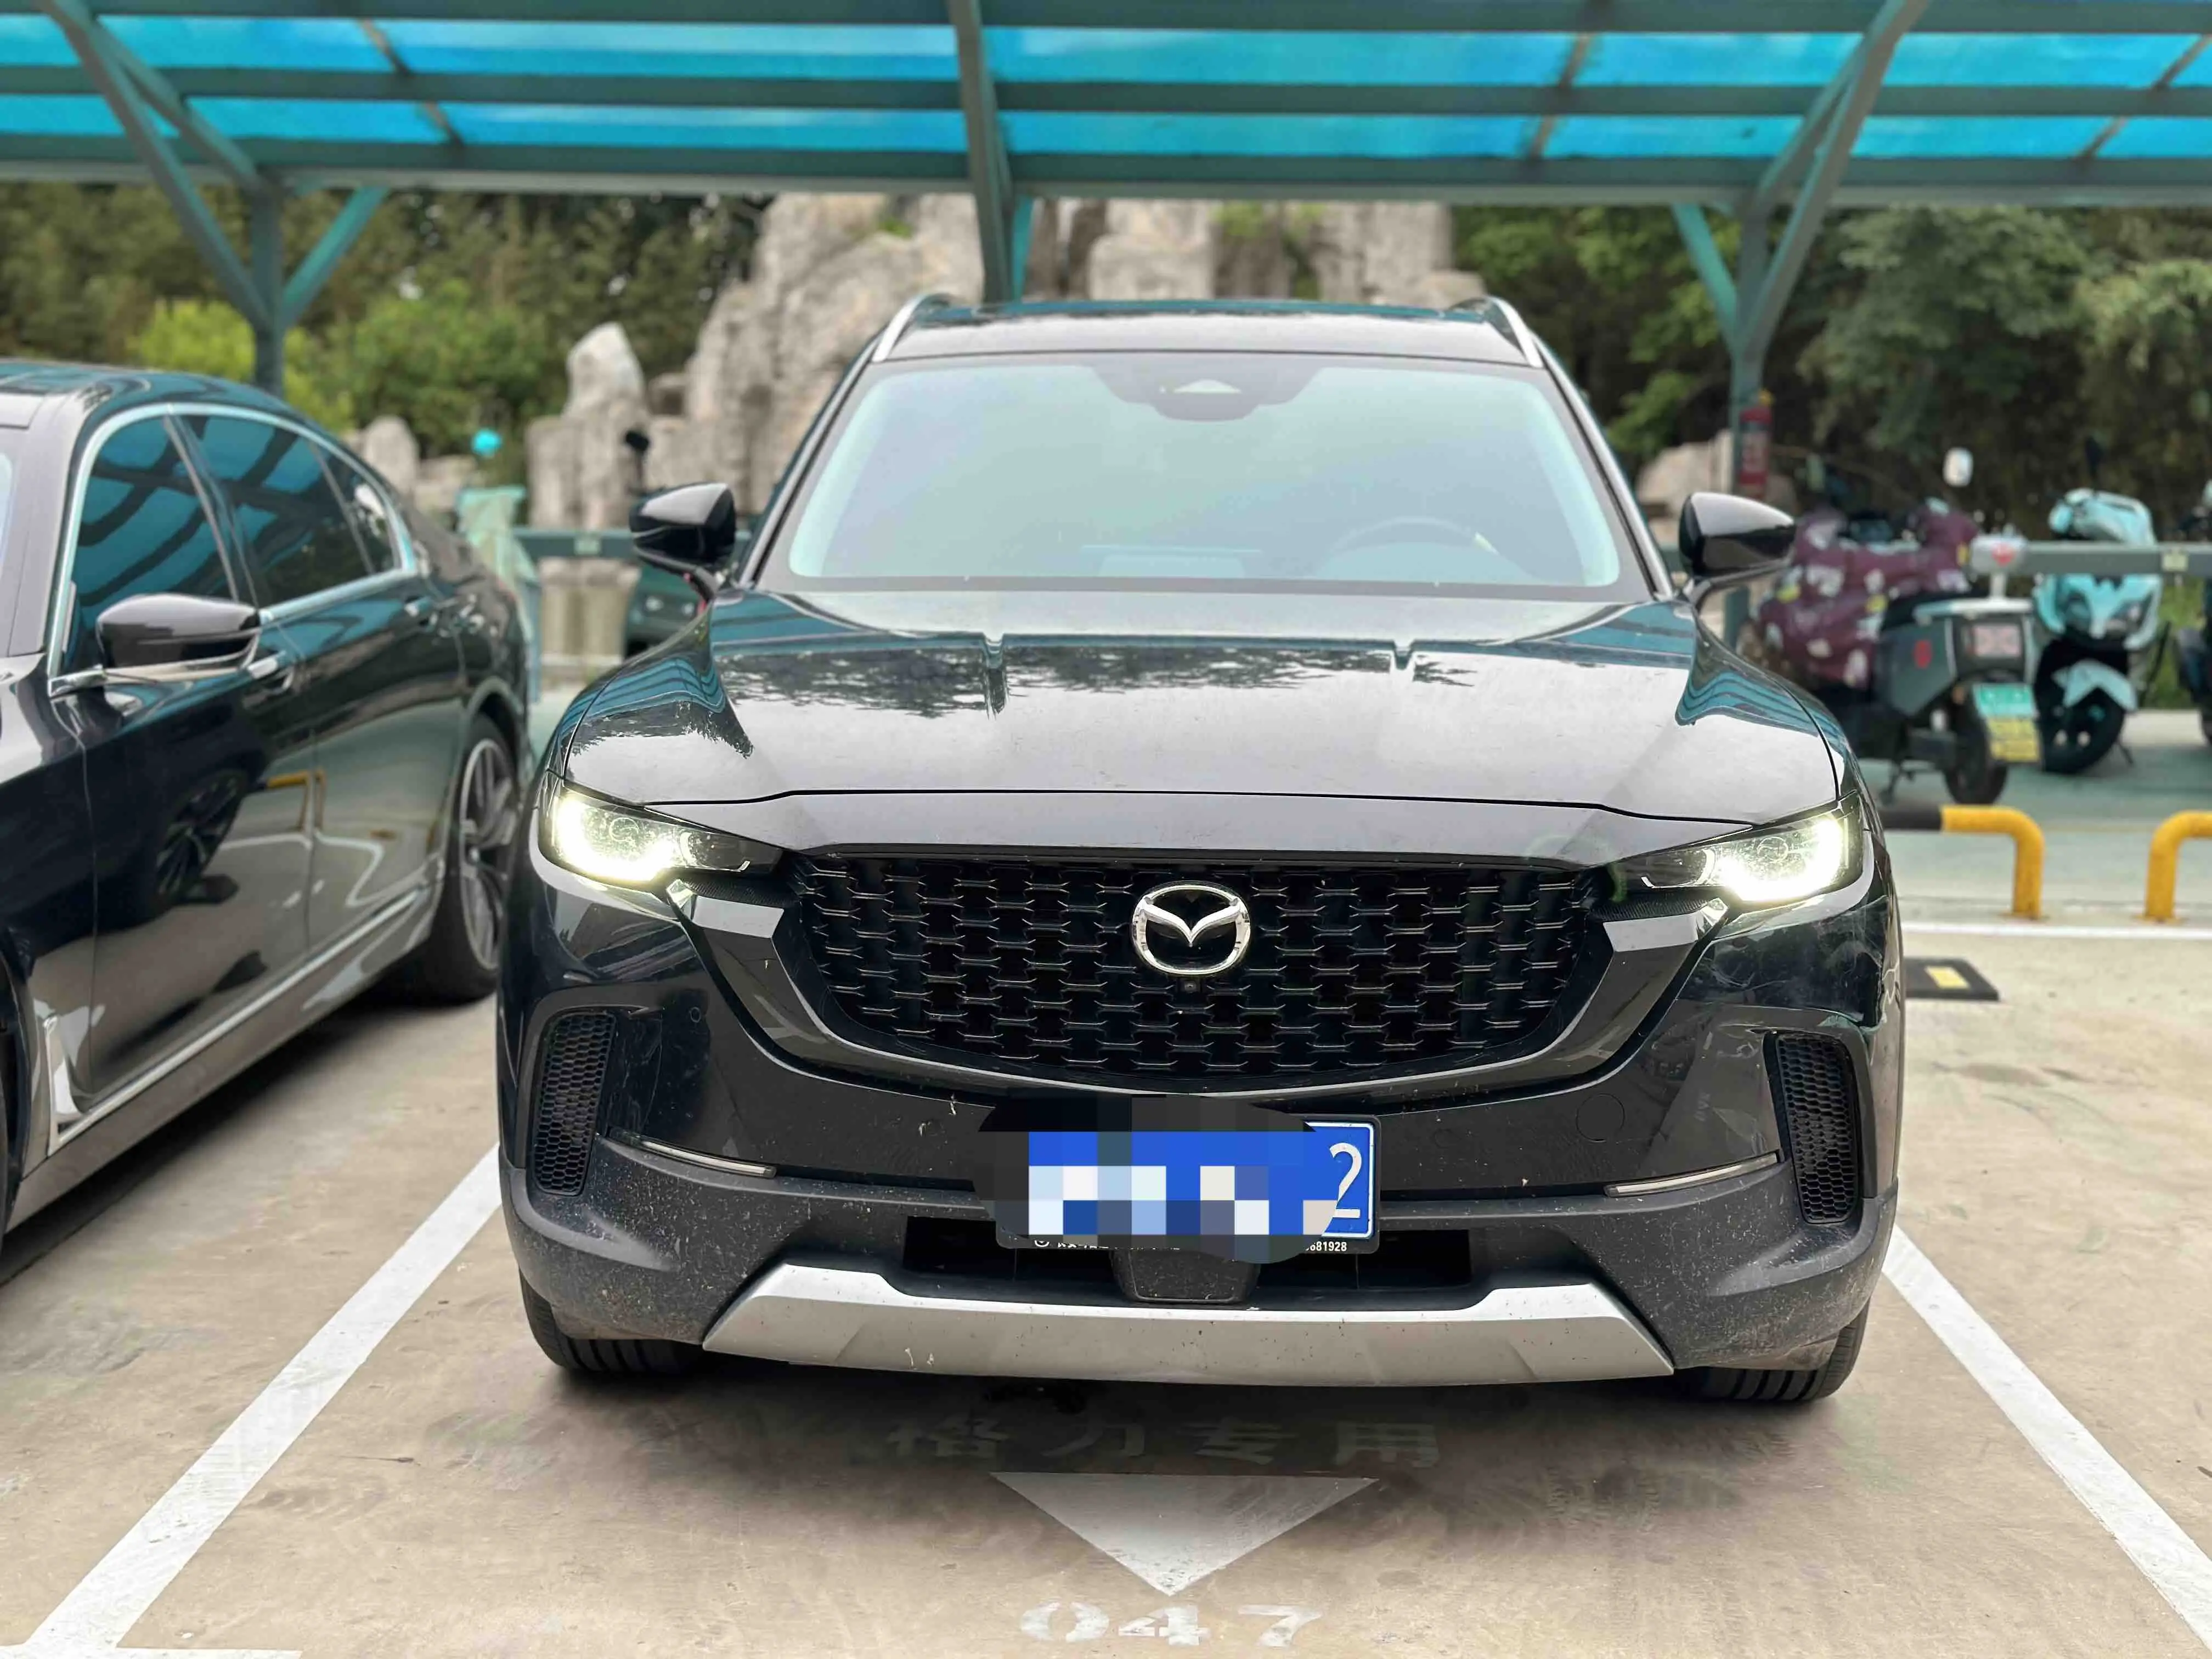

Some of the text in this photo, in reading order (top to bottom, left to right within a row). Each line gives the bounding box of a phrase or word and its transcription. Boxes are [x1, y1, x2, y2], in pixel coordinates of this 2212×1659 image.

[1329, 1142, 1362, 1218] 2
[1306, 1241, 1347, 1251] 681928
[1020, 1602, 1321, 1647] 047
